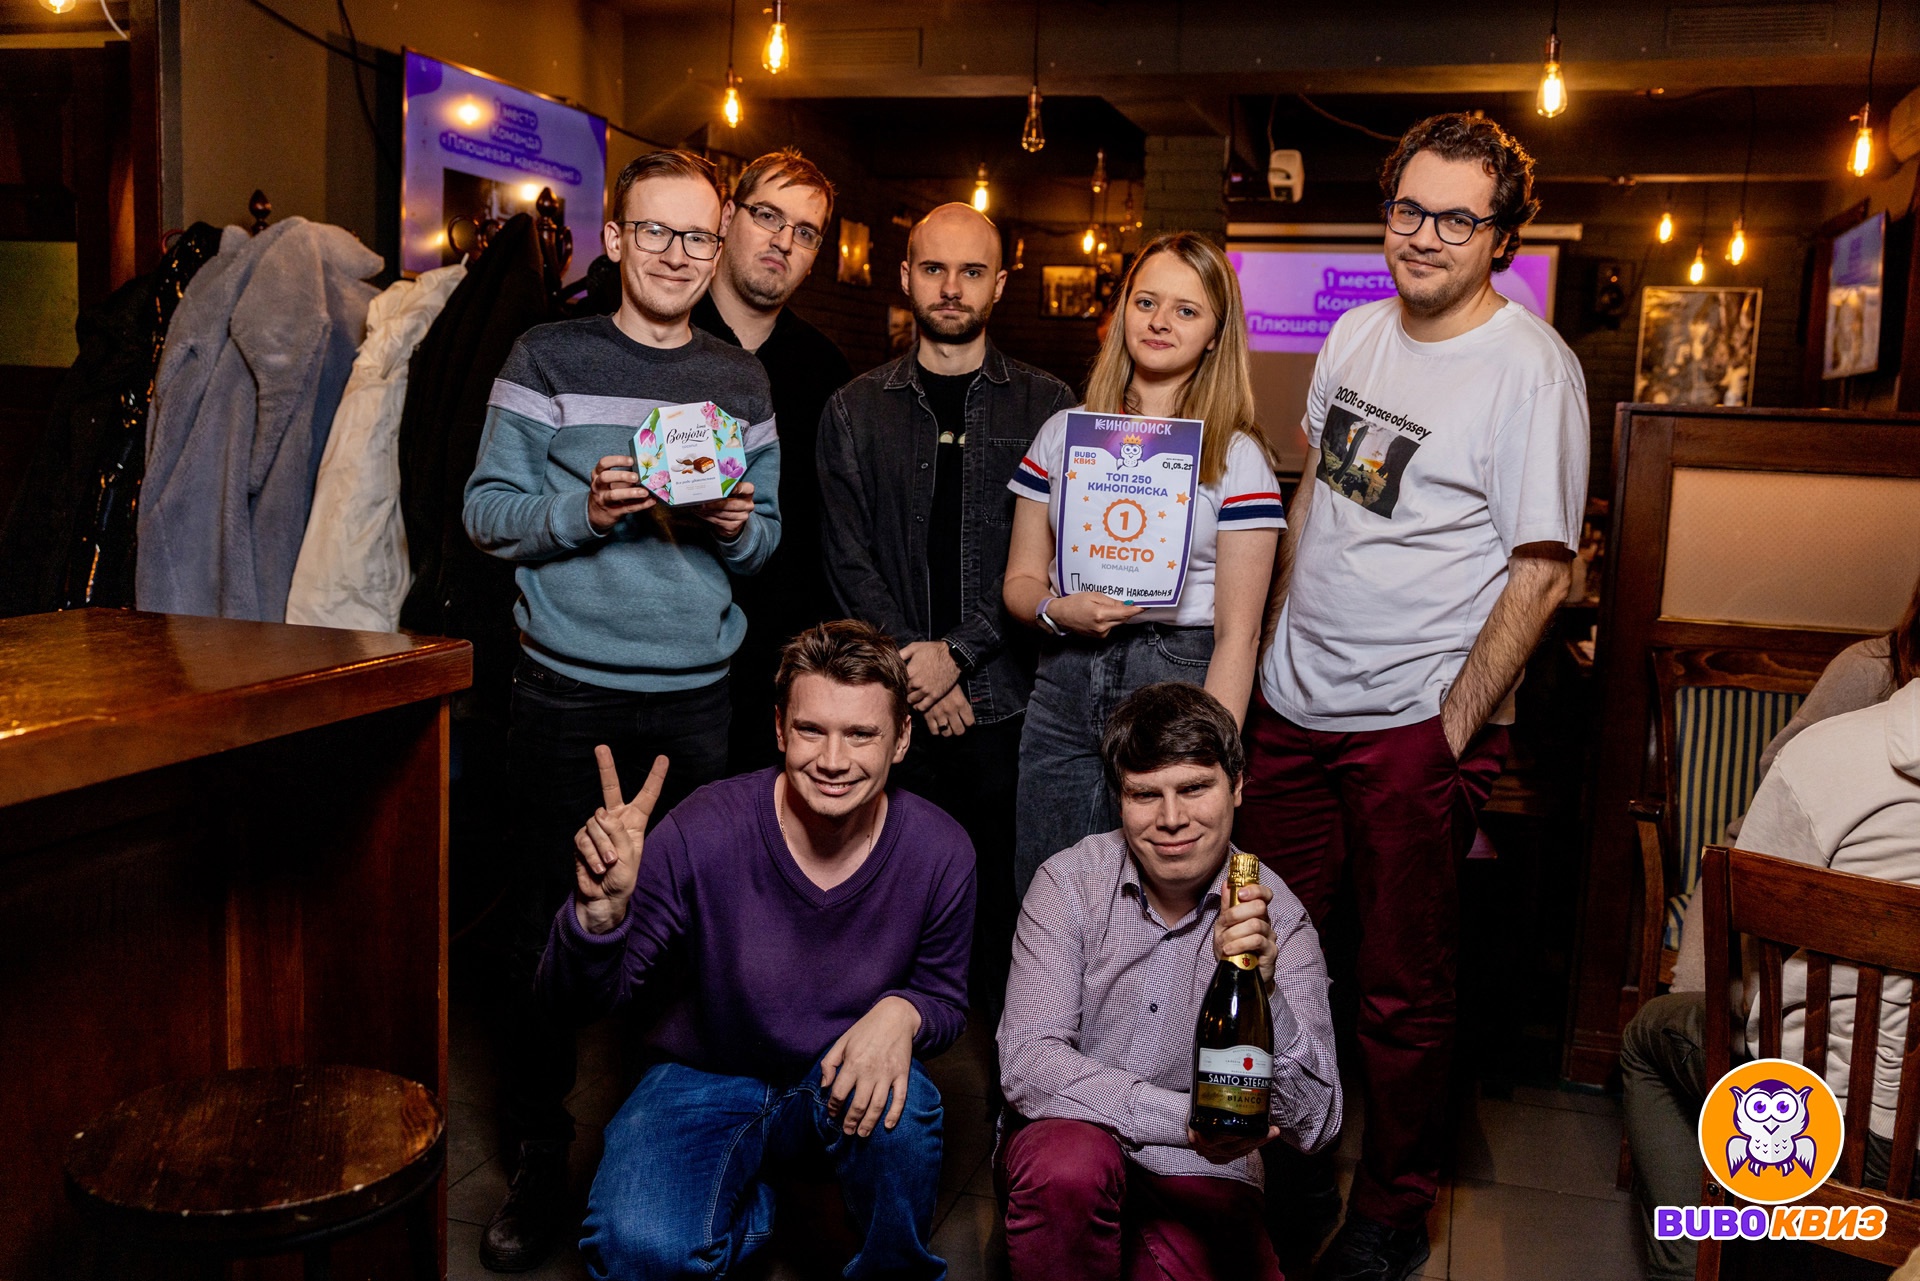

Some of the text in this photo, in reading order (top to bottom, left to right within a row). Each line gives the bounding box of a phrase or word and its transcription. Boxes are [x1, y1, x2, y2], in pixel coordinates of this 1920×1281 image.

[502, 106, 535, 127] место
[491, 125, 540, 151] Команда
[1327, 271, 1335, 287] 1
[1335, 386, 1432, 441] 2001: a space odyssey
[1095, 418, 1172, 436] КИНОПОИСК
[666, 428, 710, 444] Bonjour
[1074, 451, 1097, 459] BUBO
[1106, 472, 1152, 484] ТОП 250
[1087, 482, 1168, 497] КИНОПОИСКА
[1119, 511, 1129, 531] 1
[1089, 544, 1155, 563] МЕСТО
[1101, 563, 1140, 573] КОМАНДА
[1126, 587, 1173, 598] наковальня
[1208, 1073, 1240, 1086] SANTO
[1227, 1095, 1262, 1104] BIANCO
